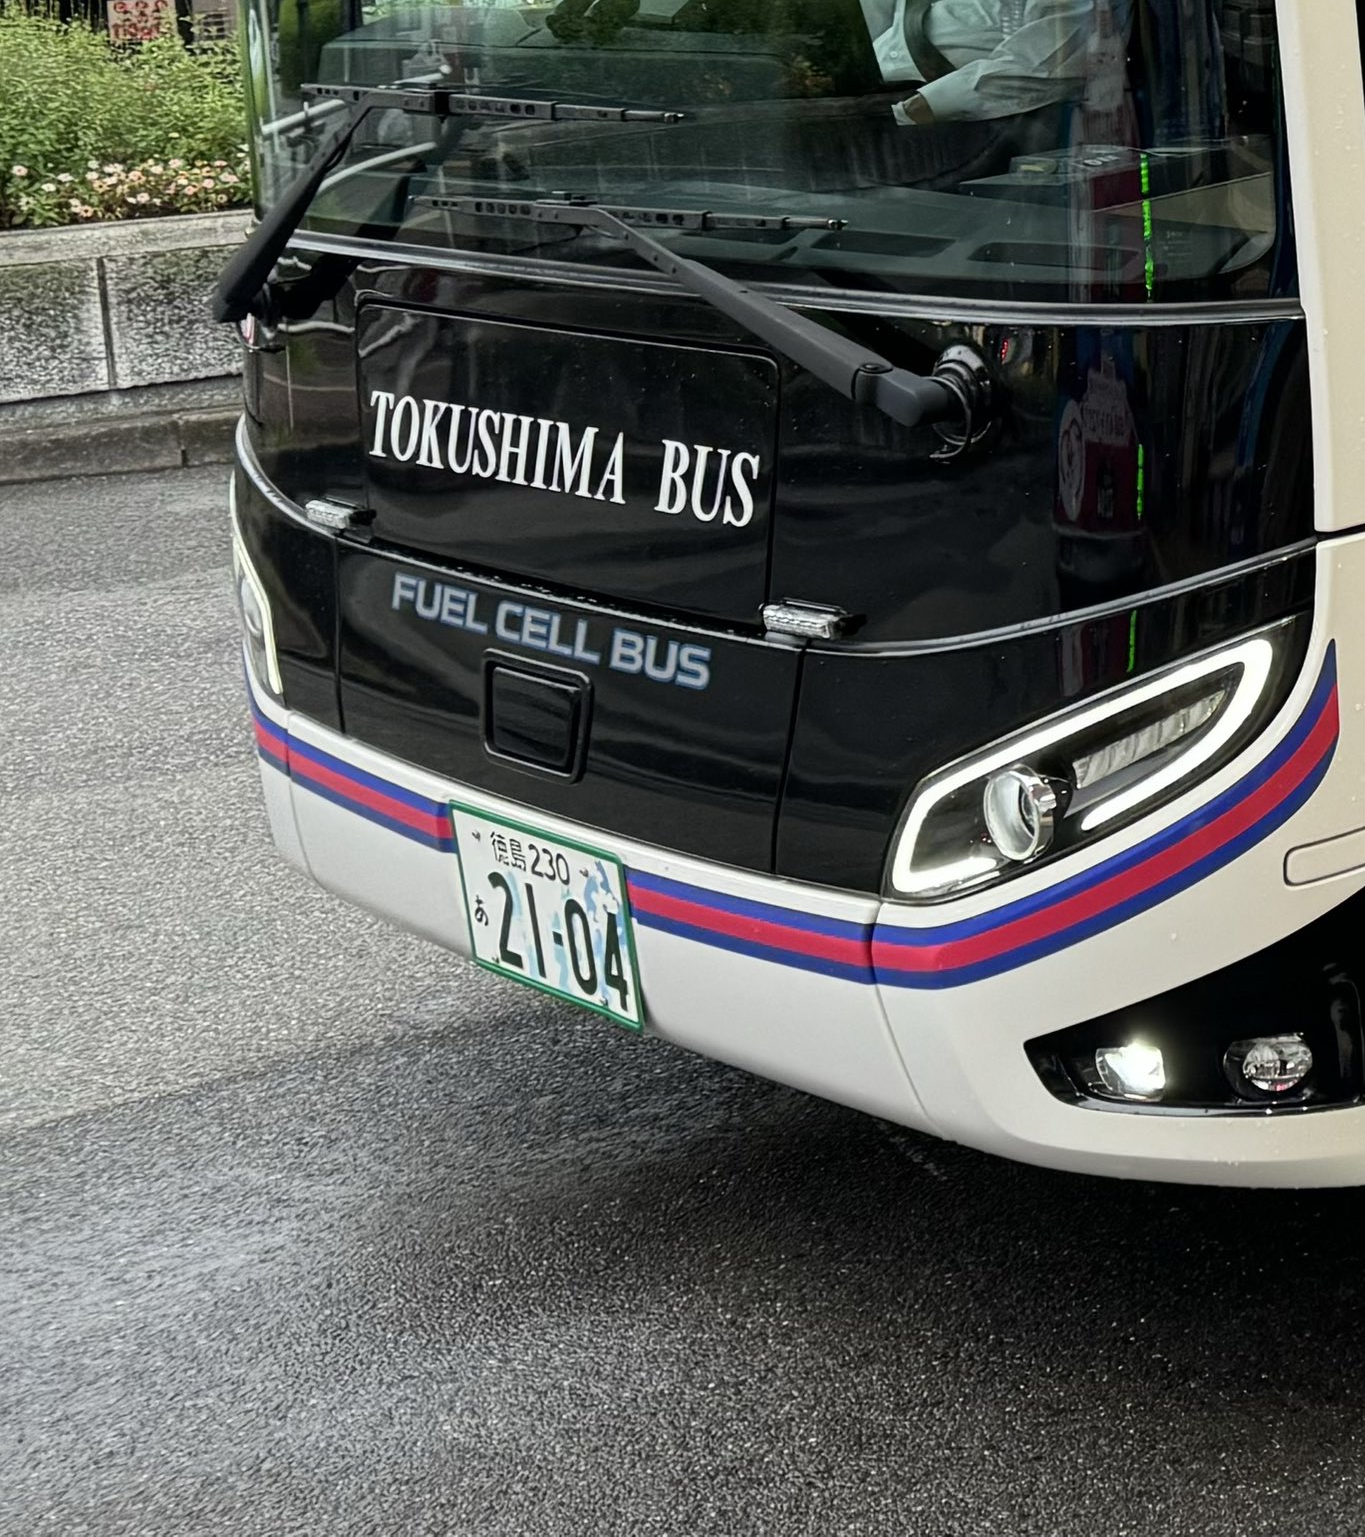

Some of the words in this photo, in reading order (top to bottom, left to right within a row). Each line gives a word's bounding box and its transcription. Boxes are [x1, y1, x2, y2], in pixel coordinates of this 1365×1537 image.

[369, 390, 626, 505] TOKUSHIMA
[653, 439, 760, 528] BUS
[390, 571, 489, 635] FUEL
[494, 599, 601, 667] CELL
[608, 628, 712, 691] BUS
[489, 830, 527, 872] 徳島
[528, 843, 571, 886] 230
[487, 871, 629, 1012] 21-04
